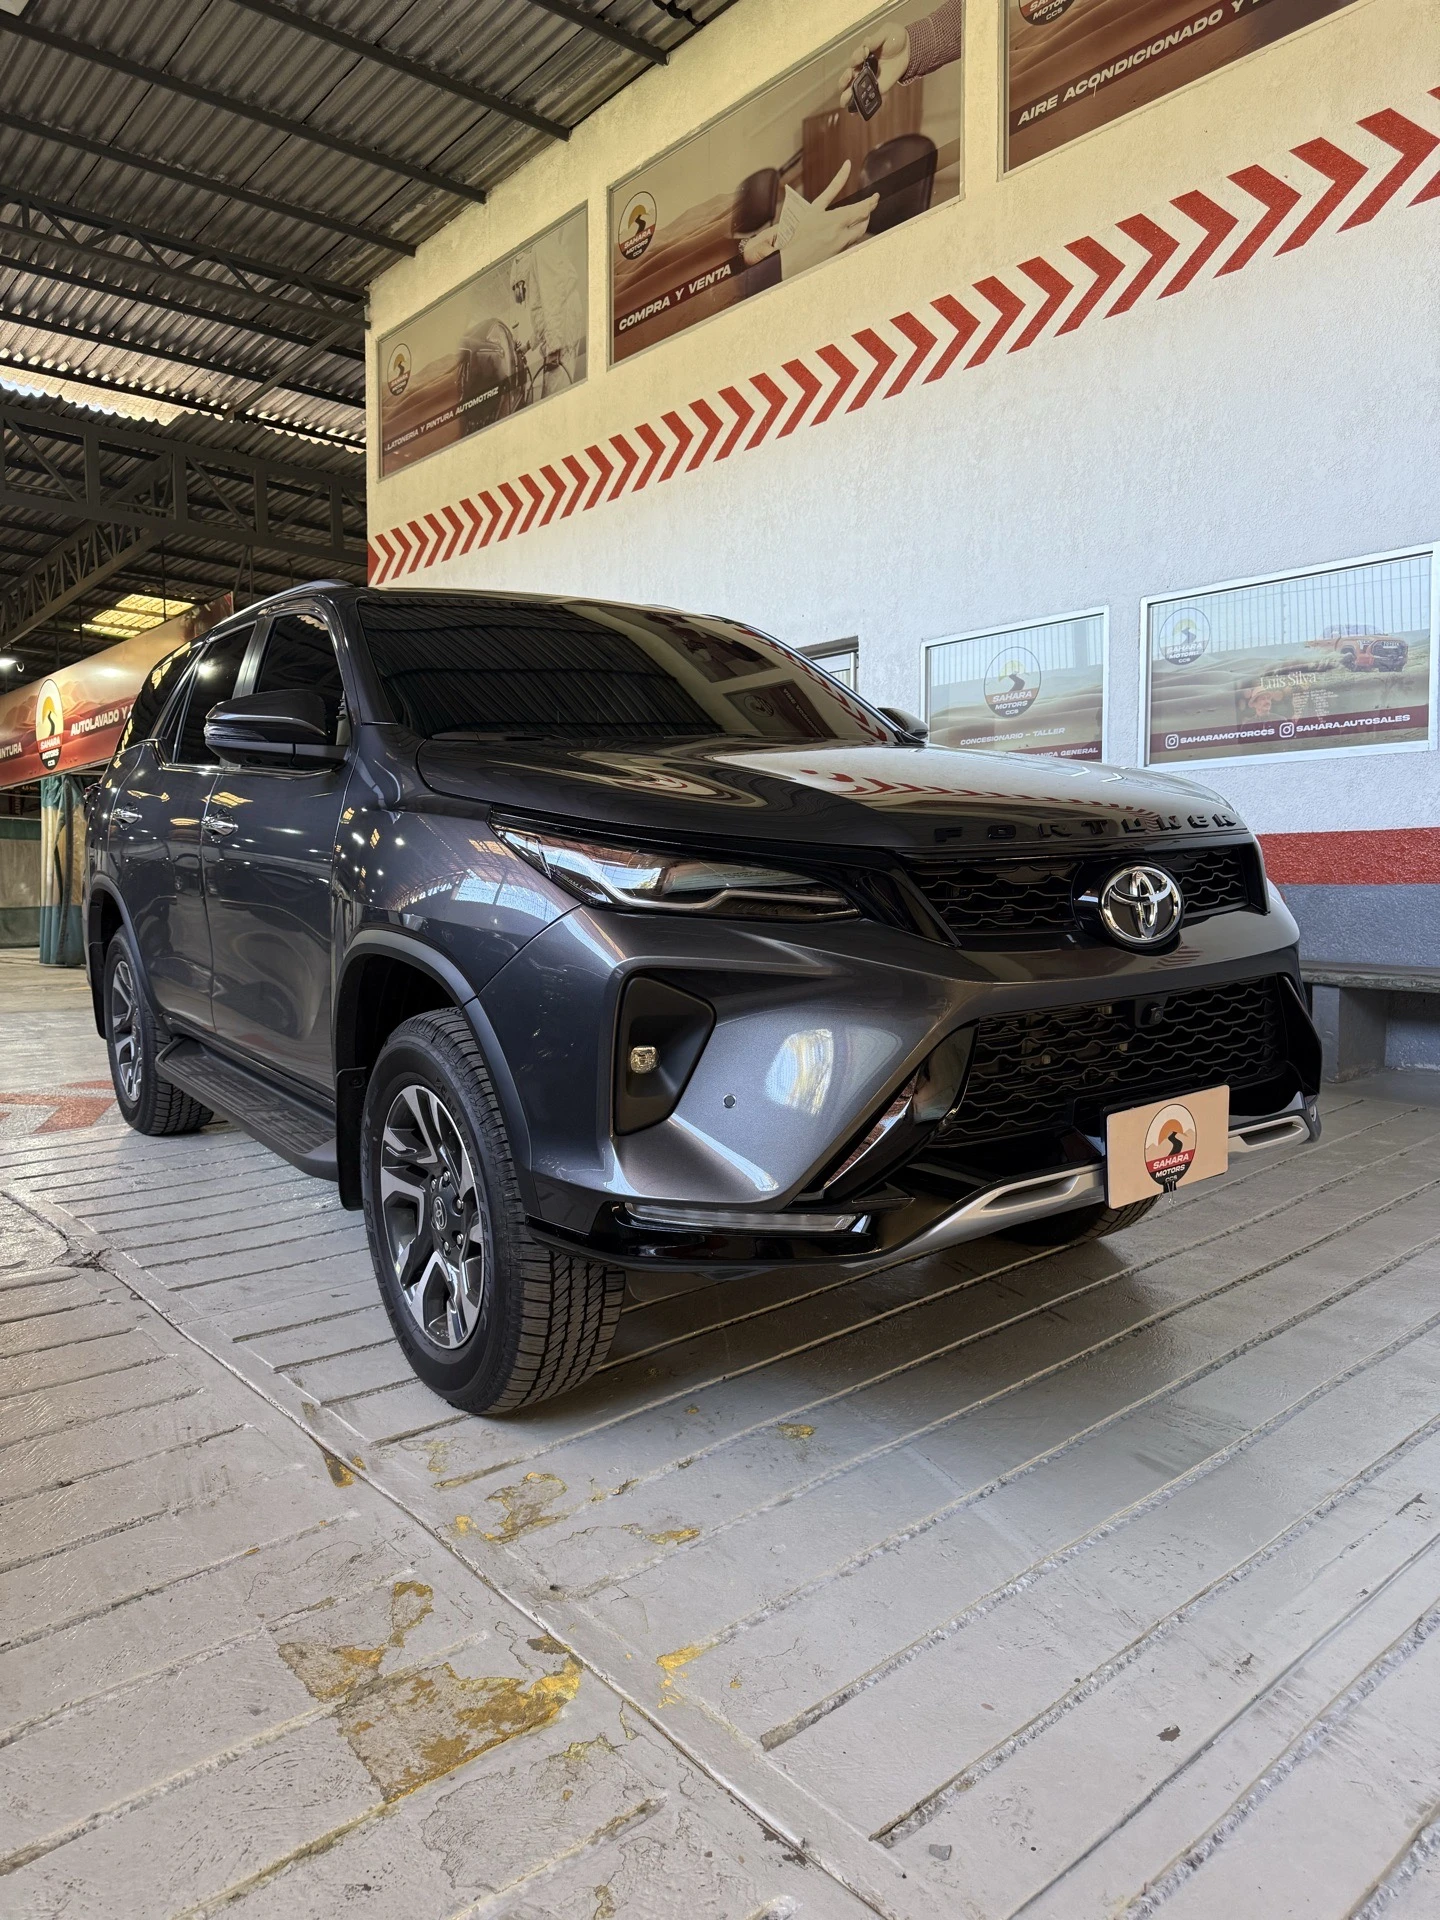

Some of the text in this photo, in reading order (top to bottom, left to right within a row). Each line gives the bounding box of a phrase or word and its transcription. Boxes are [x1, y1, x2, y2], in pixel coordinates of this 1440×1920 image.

[1046, 7, 1063, 20] CCS
[1017, 0, 1244, 126] AIRE ACONDICIONADO Y
[624, 229, 652, 249] SAHARA
[626, 239, 649, 256] MOTORS
[619, 264, 732, 331] COMPRA Y VENTA
[386, 387, 499, 451] LATONERIA Y PINTURA AUTOMOTRIZ
[1167, 643, 1203, 654] SAHARA
[1260, 671, 1317, 690] Luis Silva
[993, 691, 1032, 702] SAHARA
[995, 701, 1028, 711] MOTORS
[70, 709, 119, 736] AUTOLAVADO
[121, 705, 128, 719] Y
[1180, 714, 1411, 744] SAHARAMOTORCCS SAHARA.AUTOSALES
[40, 735, 60, 750] SAHARA
[960, 732, 1024, 746] CONCESIONARIO
[1033, 727, 1066, 737] TALLER
[1060, 747, 1099, 756] GENERAL
[934, 812, 1237, 843] FORTUNER
[1152, 1153, 1189, 1170] SAHARA
[1155, 1164, 1186, 1178] MOTORS
